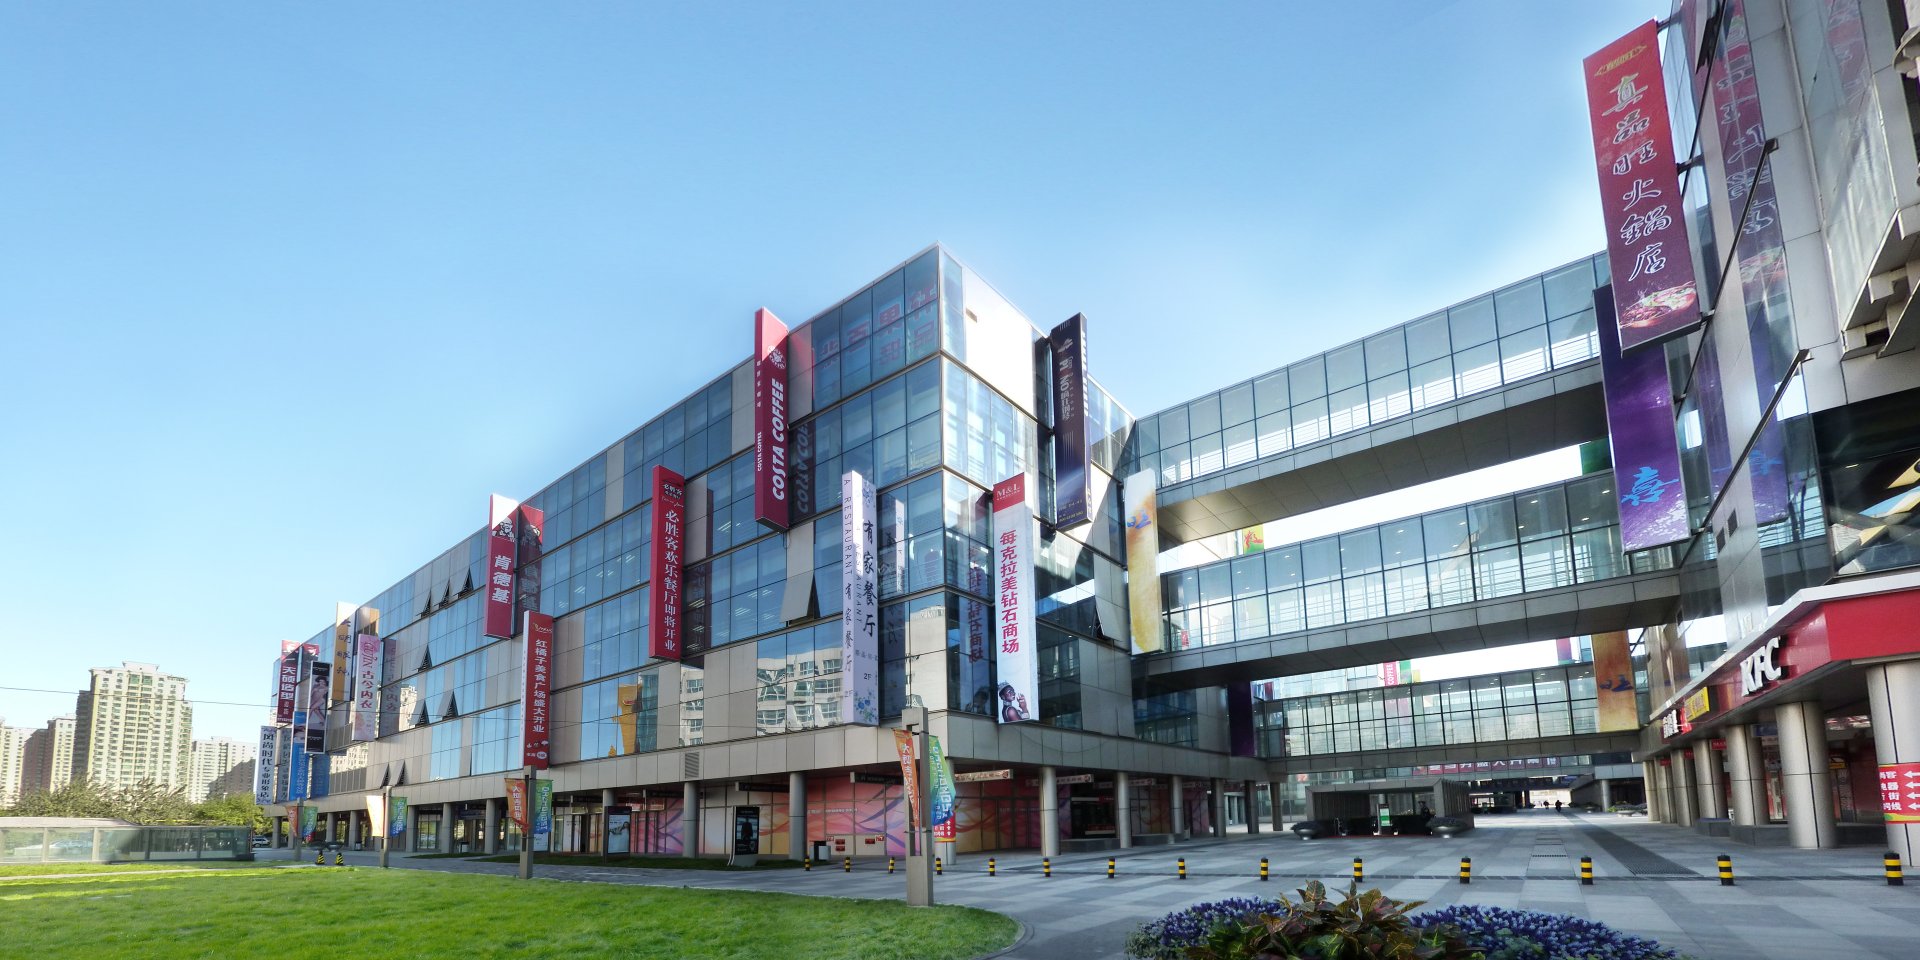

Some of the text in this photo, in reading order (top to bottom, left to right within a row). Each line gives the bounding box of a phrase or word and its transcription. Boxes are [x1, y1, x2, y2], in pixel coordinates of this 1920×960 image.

[771, 378, 784, 442] COFFEE
[772, 446, 785, 500] COSTA
[844, 496, 852, 575] RESTAURANT
[491, 555, 512, 604] 肯德基
[664, 510, 679, 651] 必胜客欢乐餐厅即将开业
[863, 520, 877, 637] 有家餐厅
[1000, 529, 1021, 654] 每克拉美钻石商场
[1740, 636, 1782, 697] KFC
